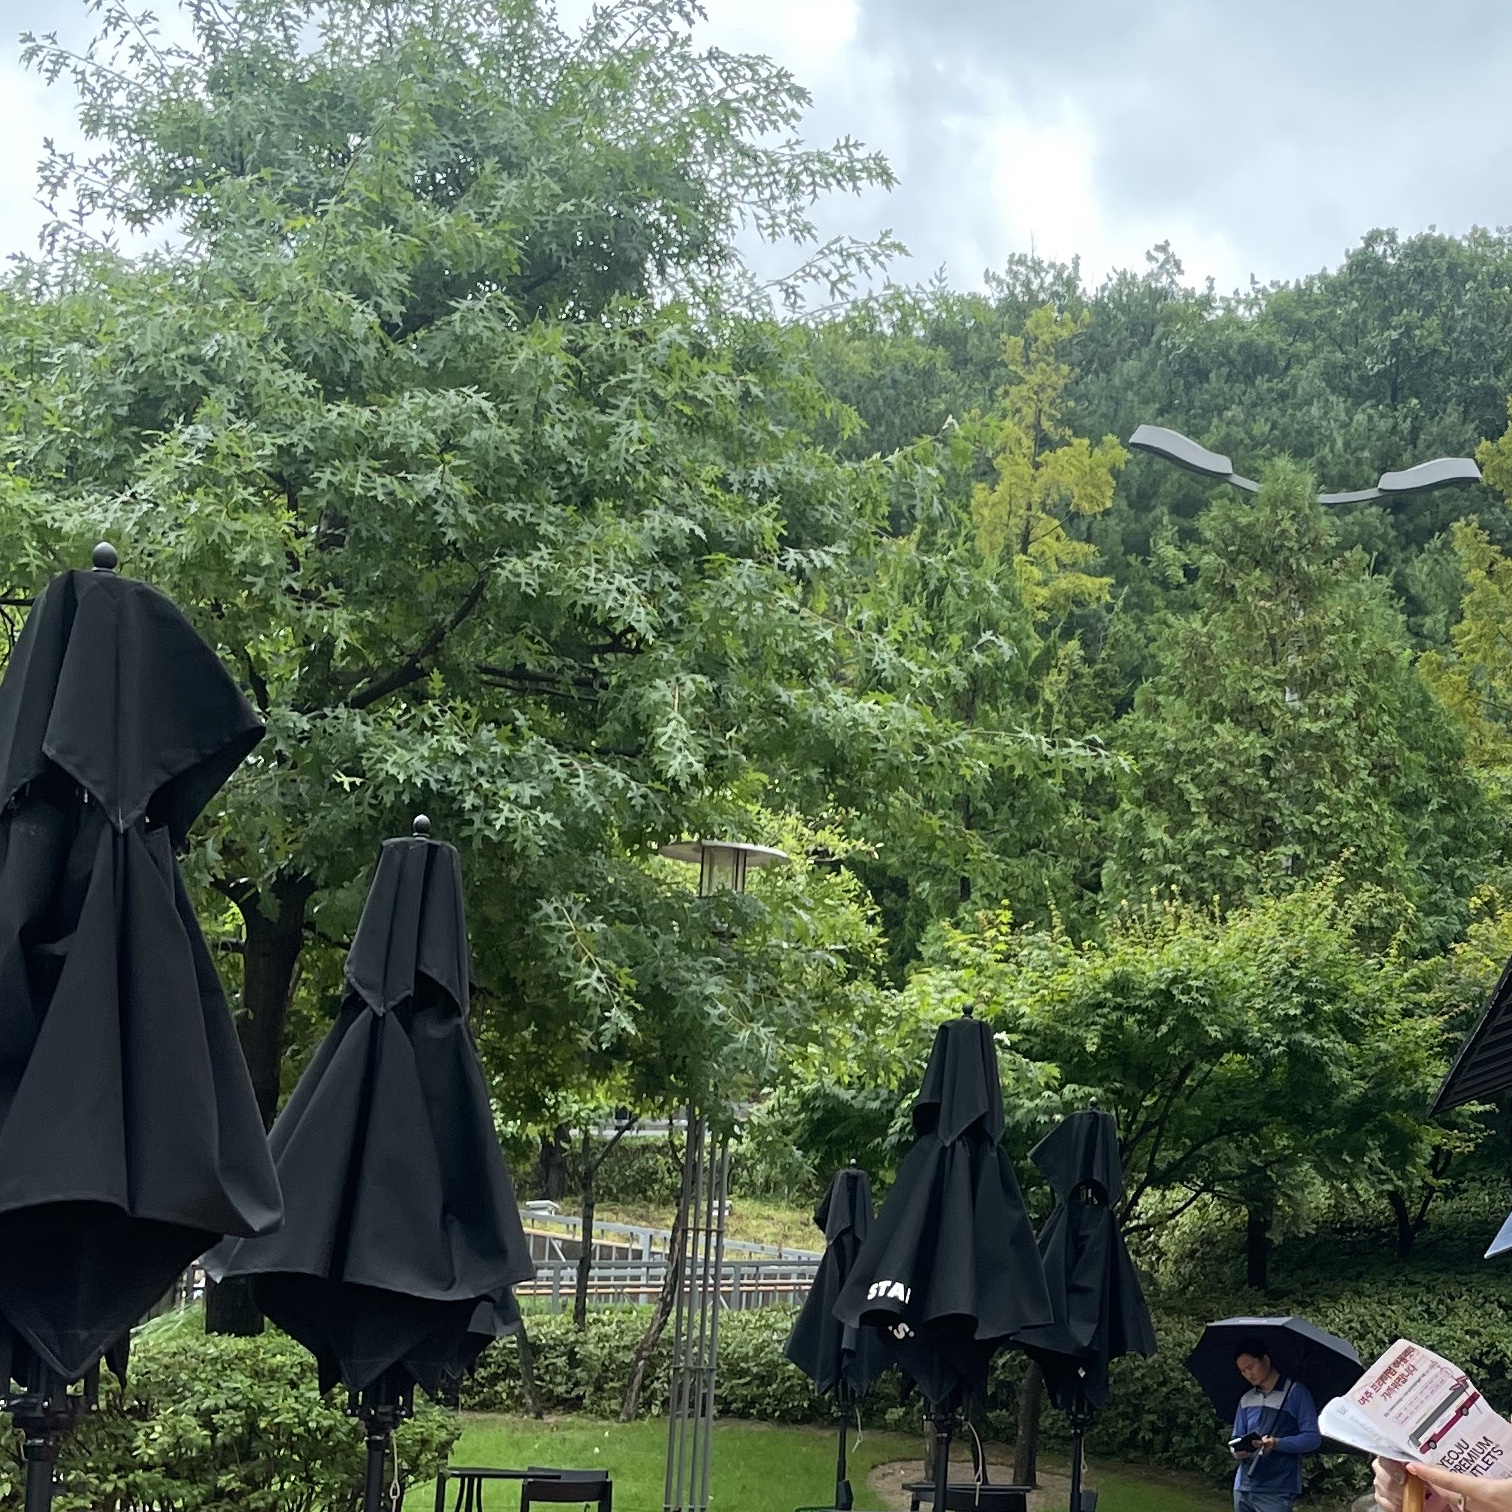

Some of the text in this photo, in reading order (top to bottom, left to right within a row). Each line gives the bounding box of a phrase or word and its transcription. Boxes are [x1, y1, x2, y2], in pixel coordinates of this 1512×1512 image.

[867, 1280, 911, 1304] STA
[1436, 1438, 1470, 1469] YEOJU
[1469, 1445, 1504, 1477] TLETS
